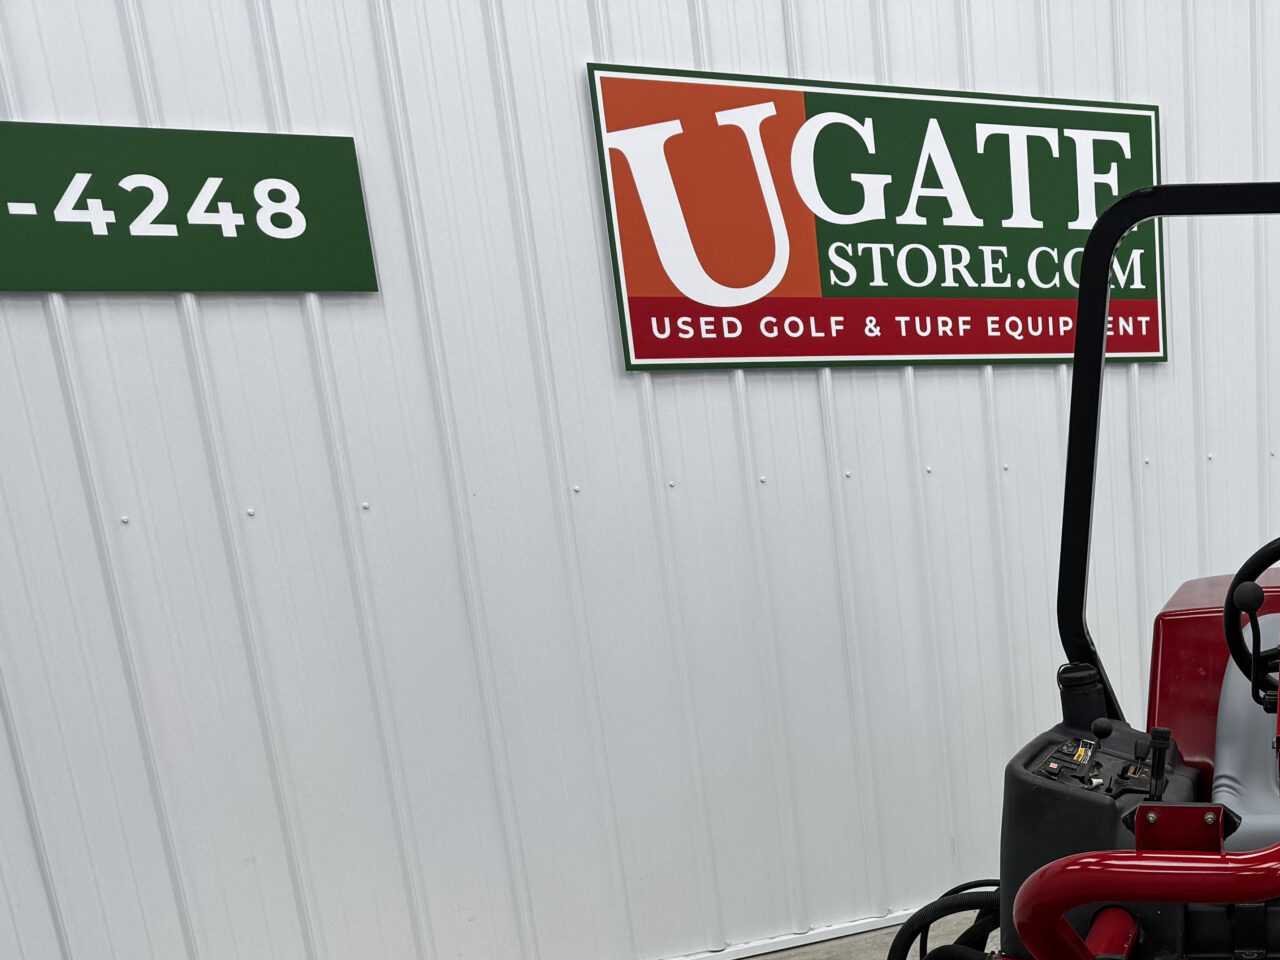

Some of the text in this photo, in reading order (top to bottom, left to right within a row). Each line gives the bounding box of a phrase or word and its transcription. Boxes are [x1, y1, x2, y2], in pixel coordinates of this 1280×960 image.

[651, 316, 1150, 340] USED GOLF & TURF EQUIPENT
